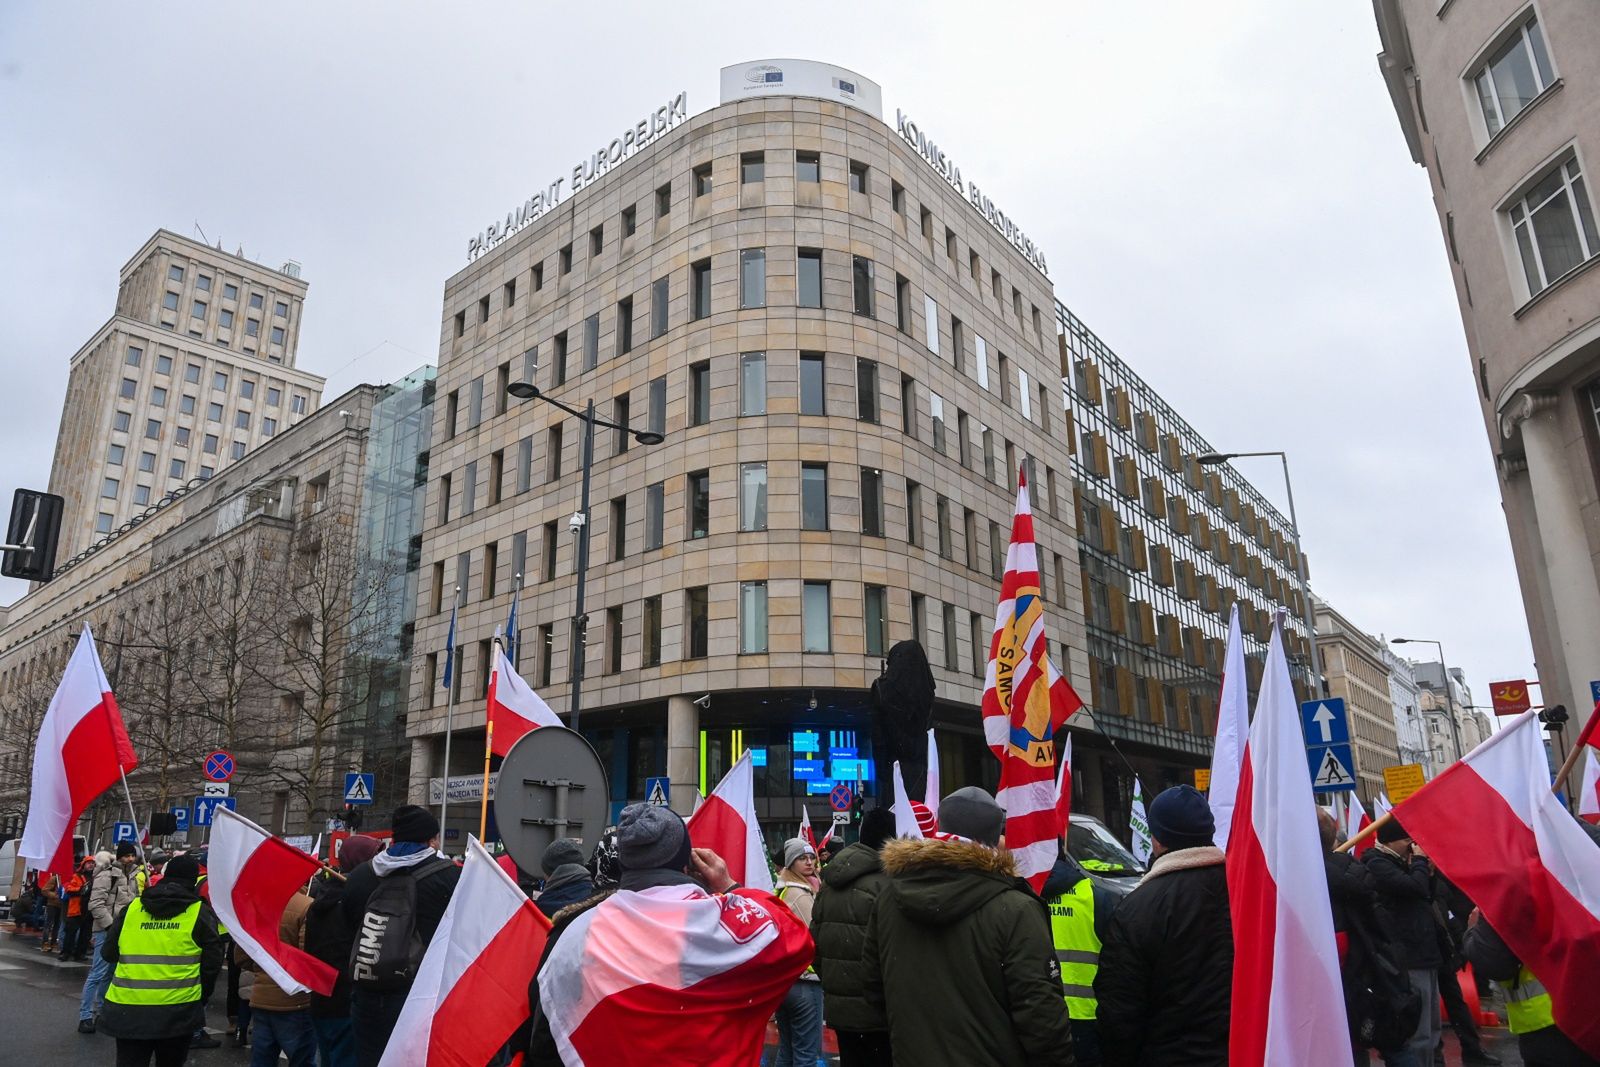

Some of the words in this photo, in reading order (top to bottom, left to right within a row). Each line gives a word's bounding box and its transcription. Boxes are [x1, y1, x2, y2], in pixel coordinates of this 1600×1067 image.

[467, 176, 564, 260] PARLAMENT
[571, 91, 687, 190] EUROPEJSKI
[896, 108, 964, 194] KOMISJA
[968, 181, 1048, 275] EUROPEJSKA
[118, 824, 132, 841] P
[140, 921, 180, 930] PODZIAŁAMI
[353, 911, 390, 981] PUMA
